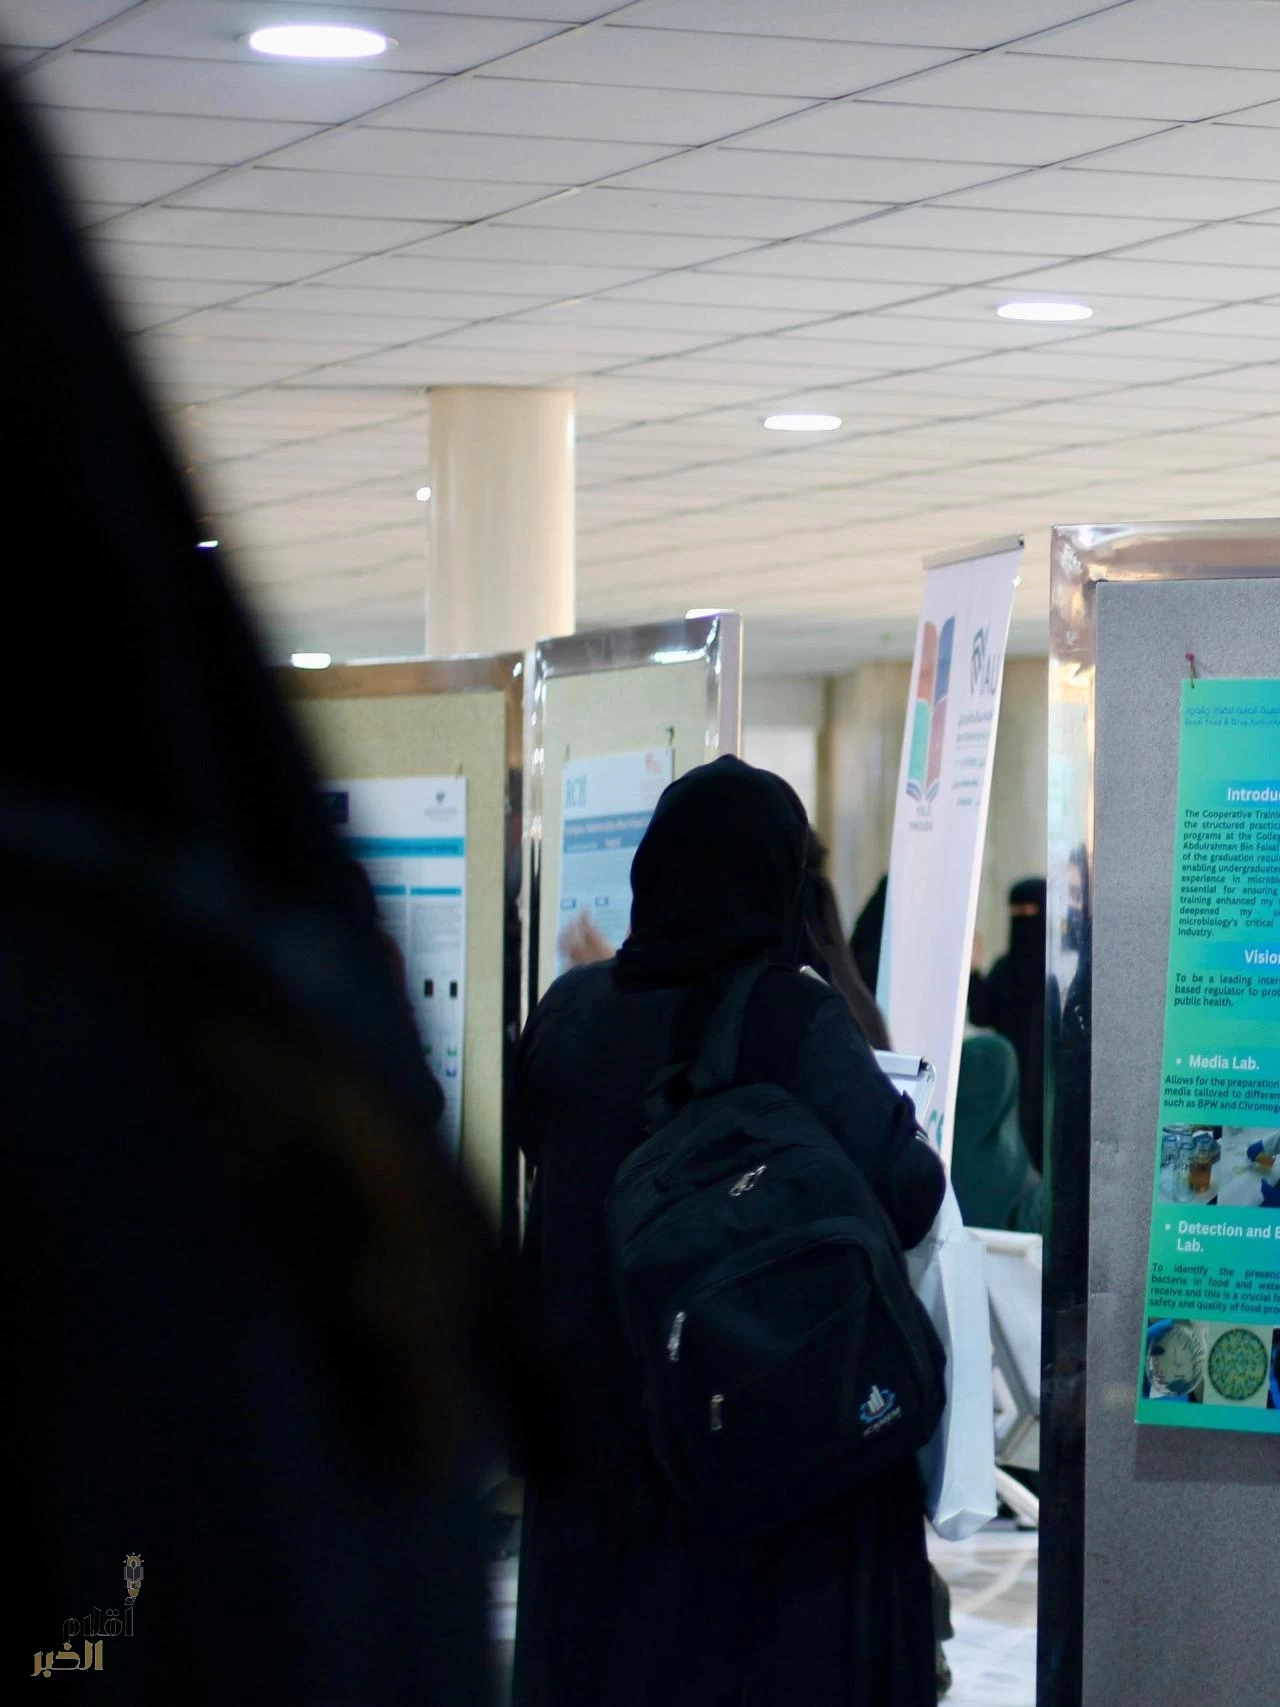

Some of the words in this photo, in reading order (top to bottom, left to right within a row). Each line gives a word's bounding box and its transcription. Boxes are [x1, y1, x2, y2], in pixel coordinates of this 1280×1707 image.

[1185, 810, 1199, 818] The
[1202, 810, 1251, 820] Cooperative
[1184, 833, 1221, 841] programs
[1239, 832, 1252, 840] the
[1183, 842, 1237, 850] Abdulrahman
[1256, 843, 1279, 851] Faisal
[1210, 853, 1254, 863] graduation
[1182, 864, 1216, 873] enabling
[1182, 875, 1225, 884] experience
[1243, 887, 1277, 896] ensuring
[1180, 896, 1211, 905] training
[1180, 907, 1219, 916] deepened
[1179, 917, 1238, 928] microbiology's
[1245, 919, 1273, 927] critical
[1220, 975, 1252, 986] leading
[1175, 985, 1200, 994] based
[1204, 987, 1245, 997] regulator
[1174, 997, 1201, 1007] public
[1189, 1055, 1229, 1069] Media
[1232, 1056, 1260, 1070] Lab.
[1166, 1075, 1193, 1084] Allows
[1211, 1077, 1225, 1086] the
[1228, 1078, 1279, 1089] preparation
[1165, 1087, 1191, 1096] media
[1194, 1088, 1228, 1097] tailored
[1164, 1099, 1184, 1107] such
[1198, 1100, 1218, 1108] BPW
[1220, 1100, 1236, 1109] and
[1179, 1220, 1243, 1237] Detection
[1246, 1226, 1270, 1239] and
[1177, 1238, 1204, 1253] Lab.
[1175, 1264, 1208, 1276] identify
[1219, 1267, 1233, 1276] the
[1152, 1275, 1187, 1285] bacteria
[1209, 1278, 1228, 1287] food
[1236, 1280, 1252, 1289] and
[1151, 1288, 1182, 1296] receive
[1185, 1288, 1201, 1297] and
[1204, 1290, 1221, 1299] this
[1241, 1292, 1270, 1301] crucial
[1150, 1298, 1176, 1308] safety
[1179, 1300, 1195, 1308] and
[1197, 1300, 1227, 1312] quality
[1241, 1303, 1261, 1312] food
